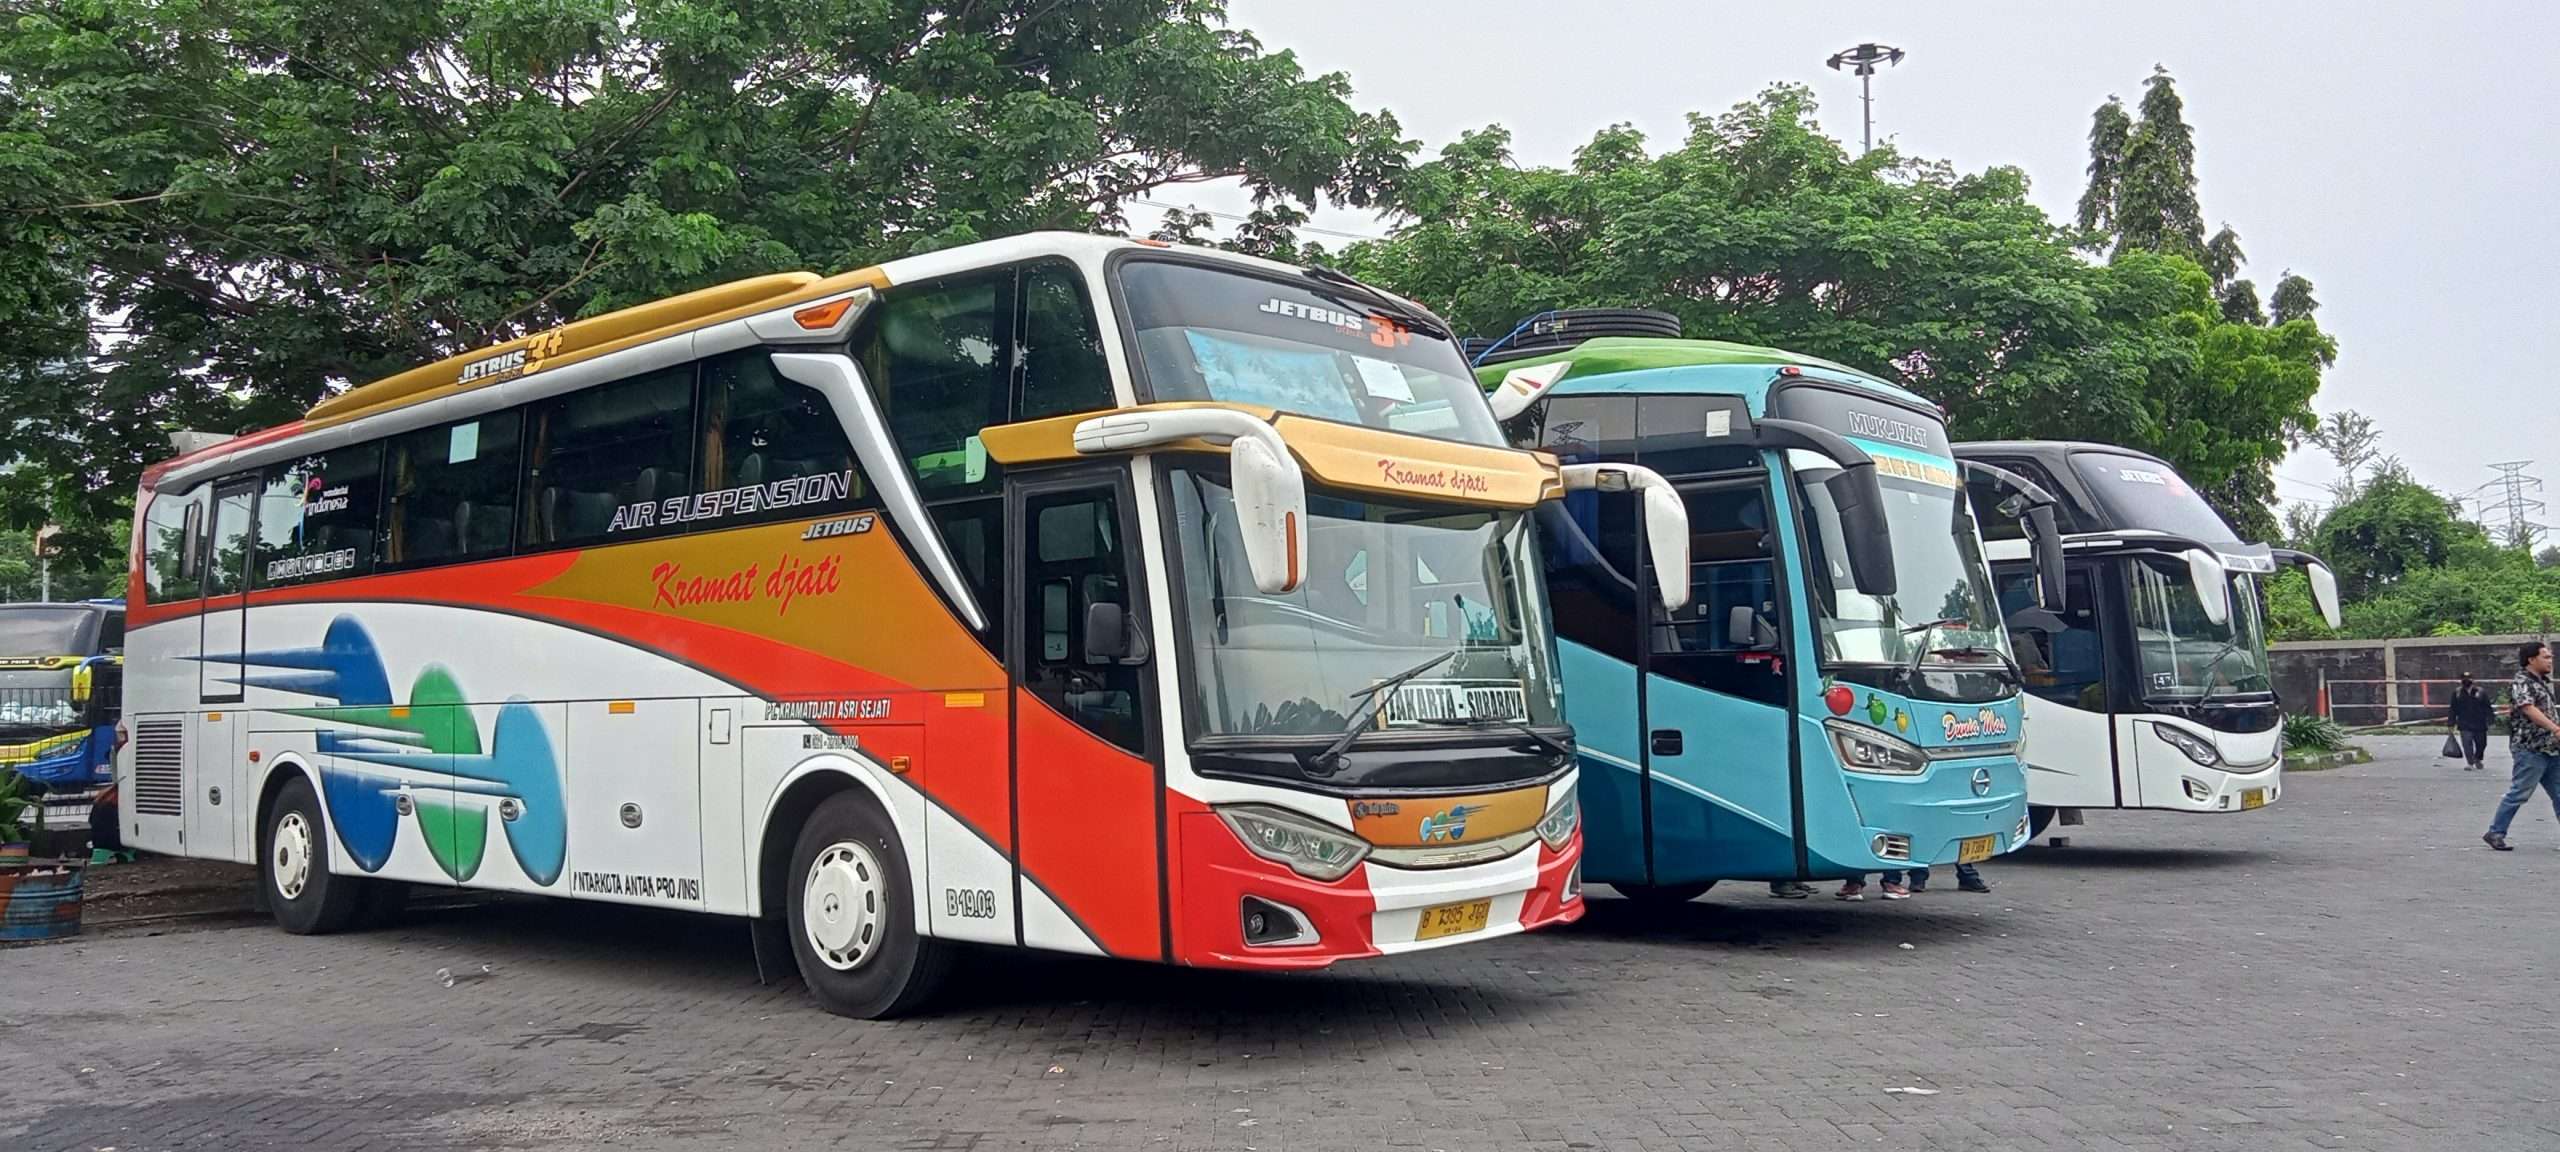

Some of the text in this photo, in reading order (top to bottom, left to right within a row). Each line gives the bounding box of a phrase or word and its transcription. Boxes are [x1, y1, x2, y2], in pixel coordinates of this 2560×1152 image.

[1259, 299, 1363, 331] JETBUS
[1377, 459, 1488, 496] Kramat djati
[608, 470, 852, 532] AIR SUSPENSION
[801, 516, 874, 540] JETBUS
[651, 553, 841, 616] Kramat djati
[780, 700, 837, 720] KRAMATDJATI
[838, 700, 859, 719] ASRI
[860, 698, 891, 718] SEJATI
[1388, 688, 1457, 721] JAKARTA
